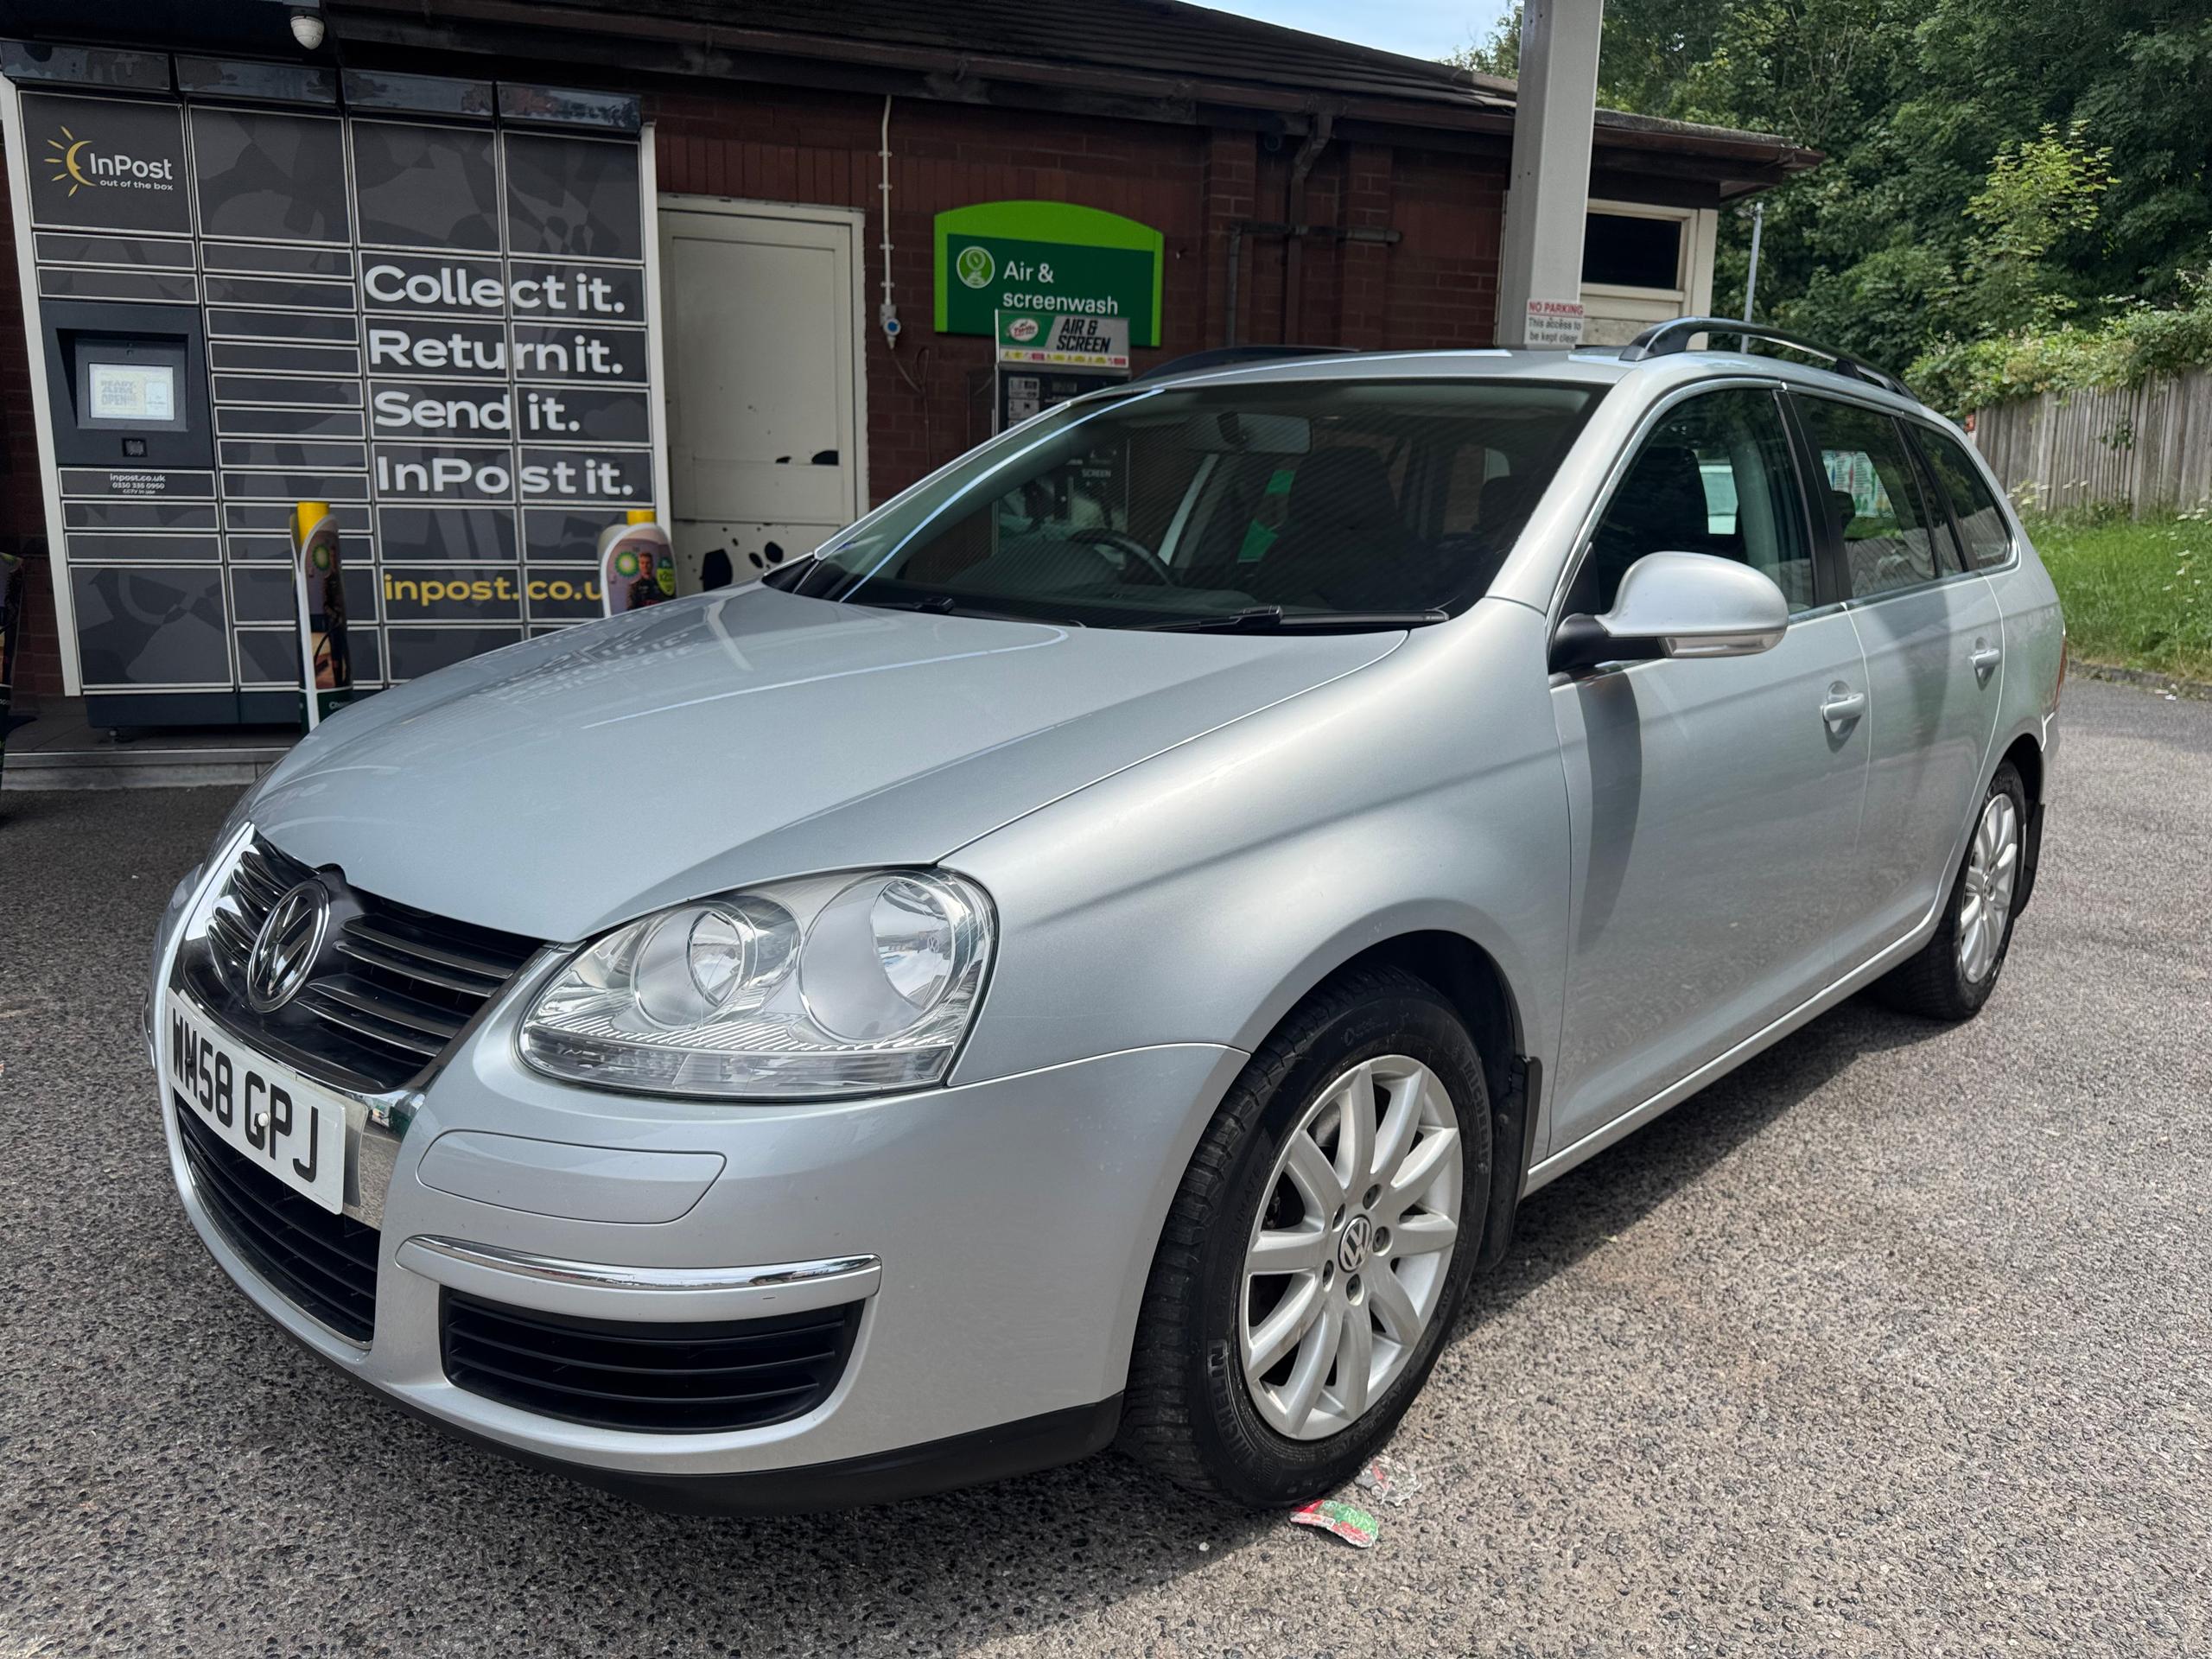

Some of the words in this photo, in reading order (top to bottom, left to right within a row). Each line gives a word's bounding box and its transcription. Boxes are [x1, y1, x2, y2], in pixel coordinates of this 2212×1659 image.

[90, 153, 173, 180] InPost
[133, 181, 151, 189] the
[154, 182, 173, 191] box
[1003, 261, 1034, 282] Air
[1038, 263, 1054, 283] &
[365, 264, 567, 310] Collect
[575, 272, 626, 314] it.
[1003, 292, 1118, 315] screenwash
[1529, 302, 1542, 312] NO
[1544, 302, 1584, 315] PARKING
[1061, 318, 1086, 334] AIR
[1087, 319, 1098, 336] &
[1545, 320, 1573, 330] access
[368, 329, 569, 372] Return
[574, 334, 624, 375] it.
[1056, 334, 1111, 353] SCREEN
[373, 391, 512, 430] Send
[527, 392, 581, 432] it.
[110, 473, 166, 483] inpost.co.uk
[377, 455, 577, 494] InPost
[585, 458, 634, 496] it.
[384, 574, 603, 607] inpost.co.u
[245, 1071, 319, 1183] GPJ
